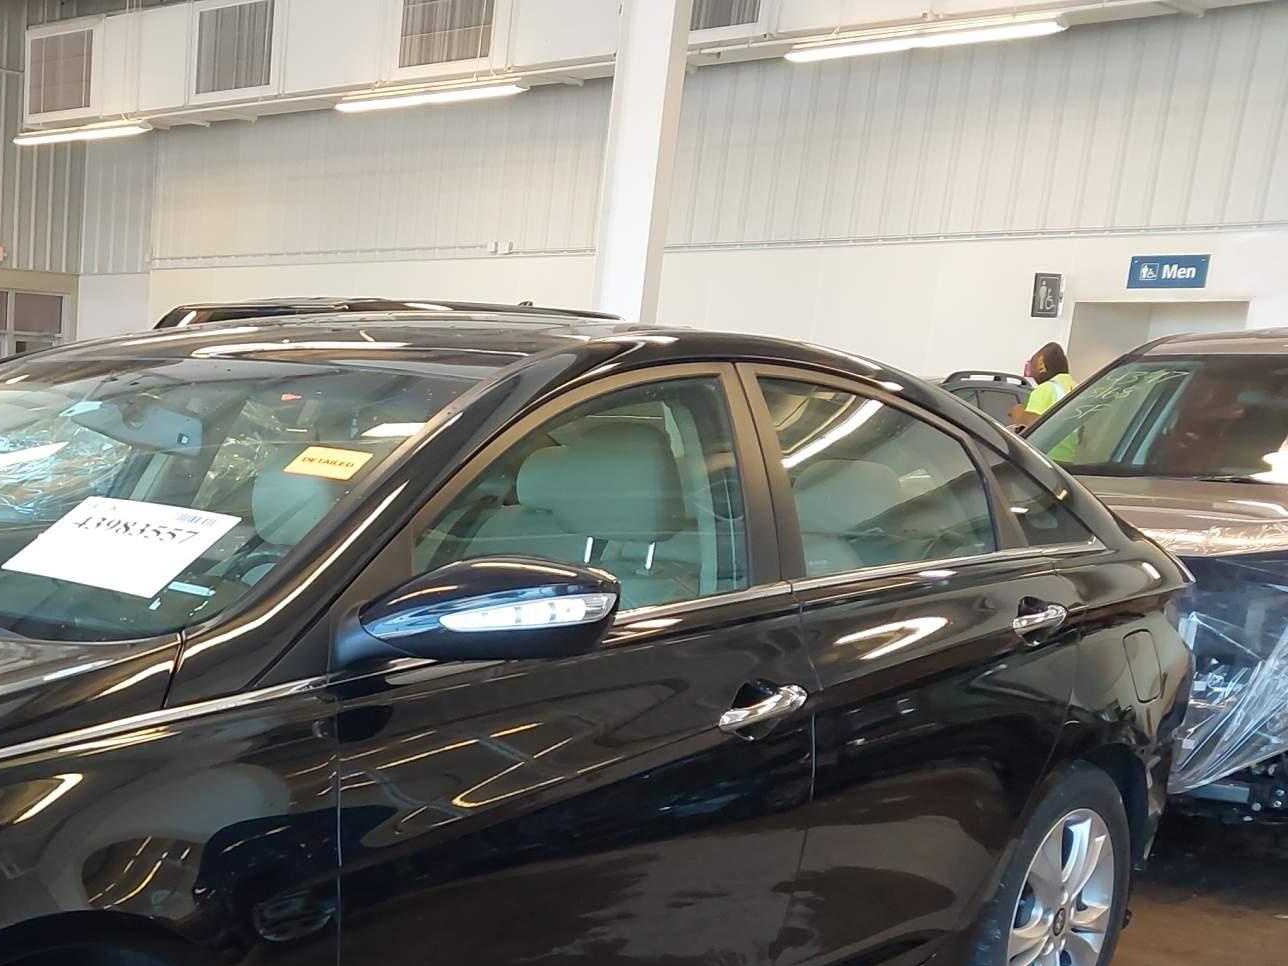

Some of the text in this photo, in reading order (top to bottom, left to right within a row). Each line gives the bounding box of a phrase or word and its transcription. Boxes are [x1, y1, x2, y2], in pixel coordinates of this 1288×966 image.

[1161, 263, 1197, 280] Men
[301, 455, 355, 469] DETAILED
[73, 515, 200, 545] 43983557
